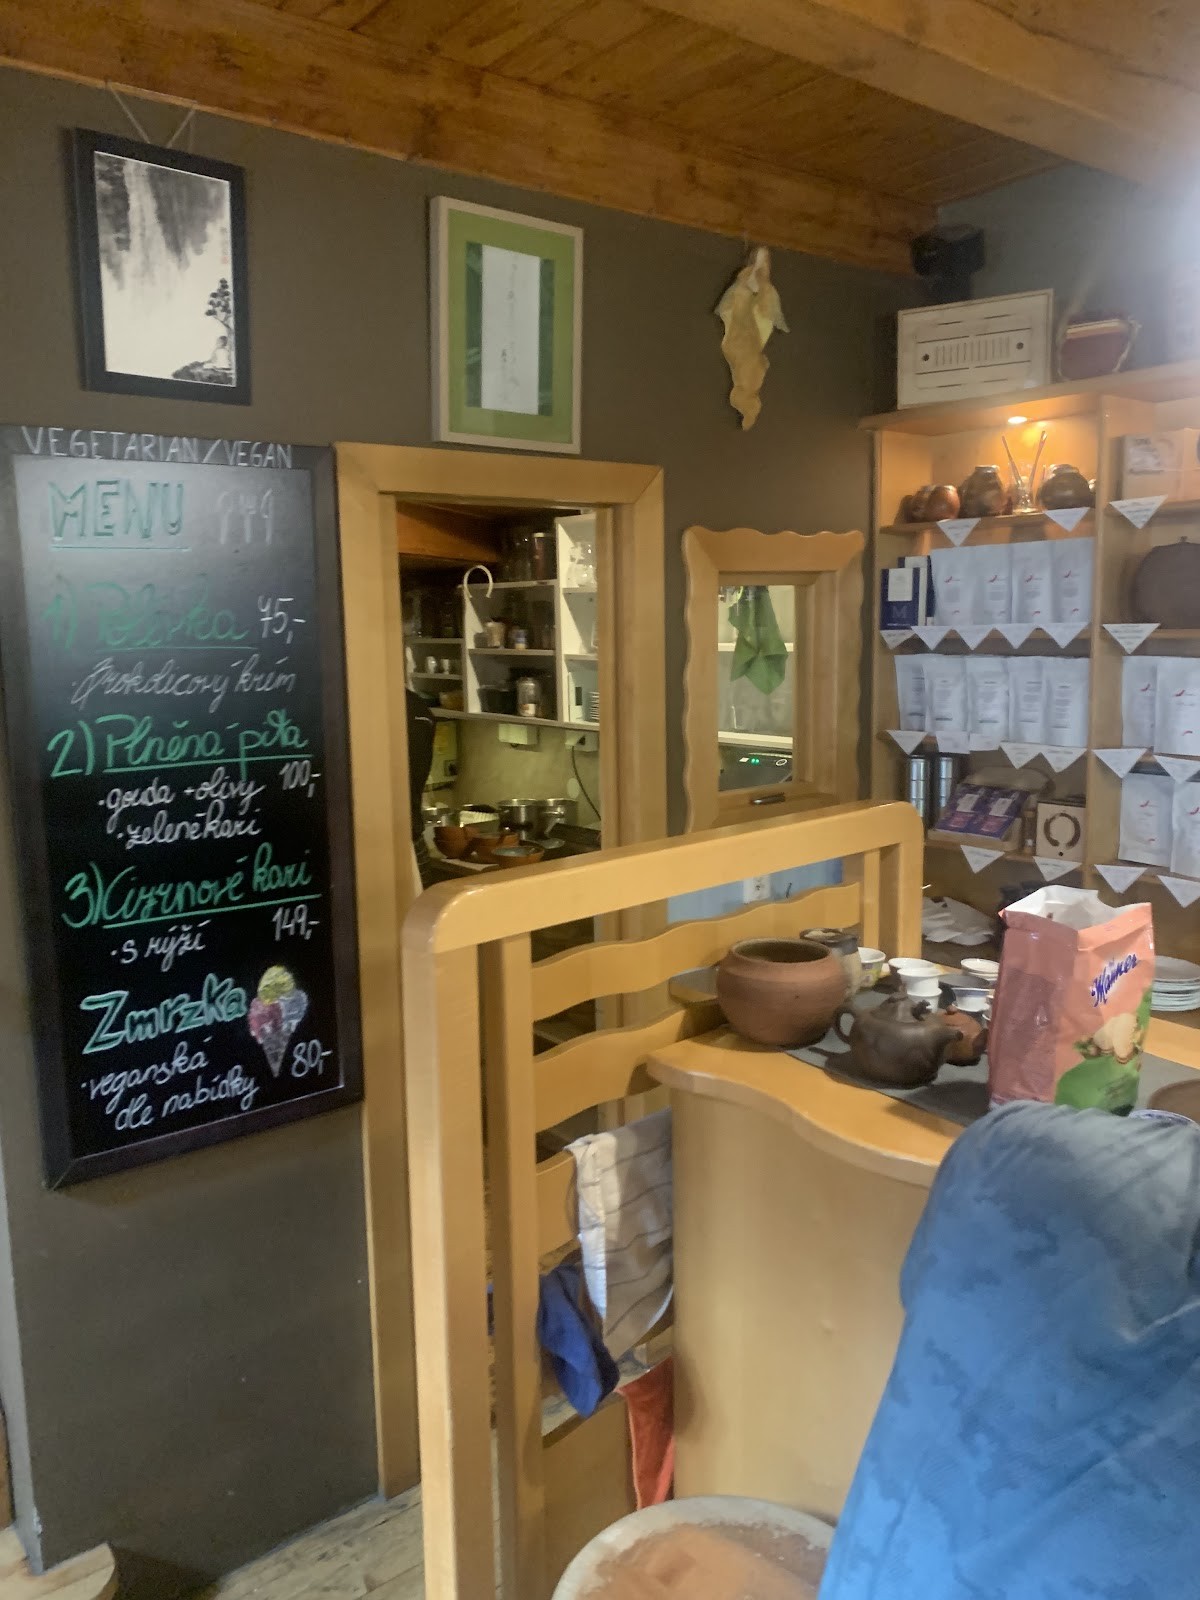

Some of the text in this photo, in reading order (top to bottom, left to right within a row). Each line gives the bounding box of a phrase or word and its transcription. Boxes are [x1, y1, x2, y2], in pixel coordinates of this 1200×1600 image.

[49, 479, 185, 539] MENU
[47, 719, 95, 778] 2)
[203, 800, 263, 840] kari
[252, 841, 313, 893] kari
[80, 973, 248, 1055] Zmrzka
[114, 1064, 260, 1131] dle nabídky
